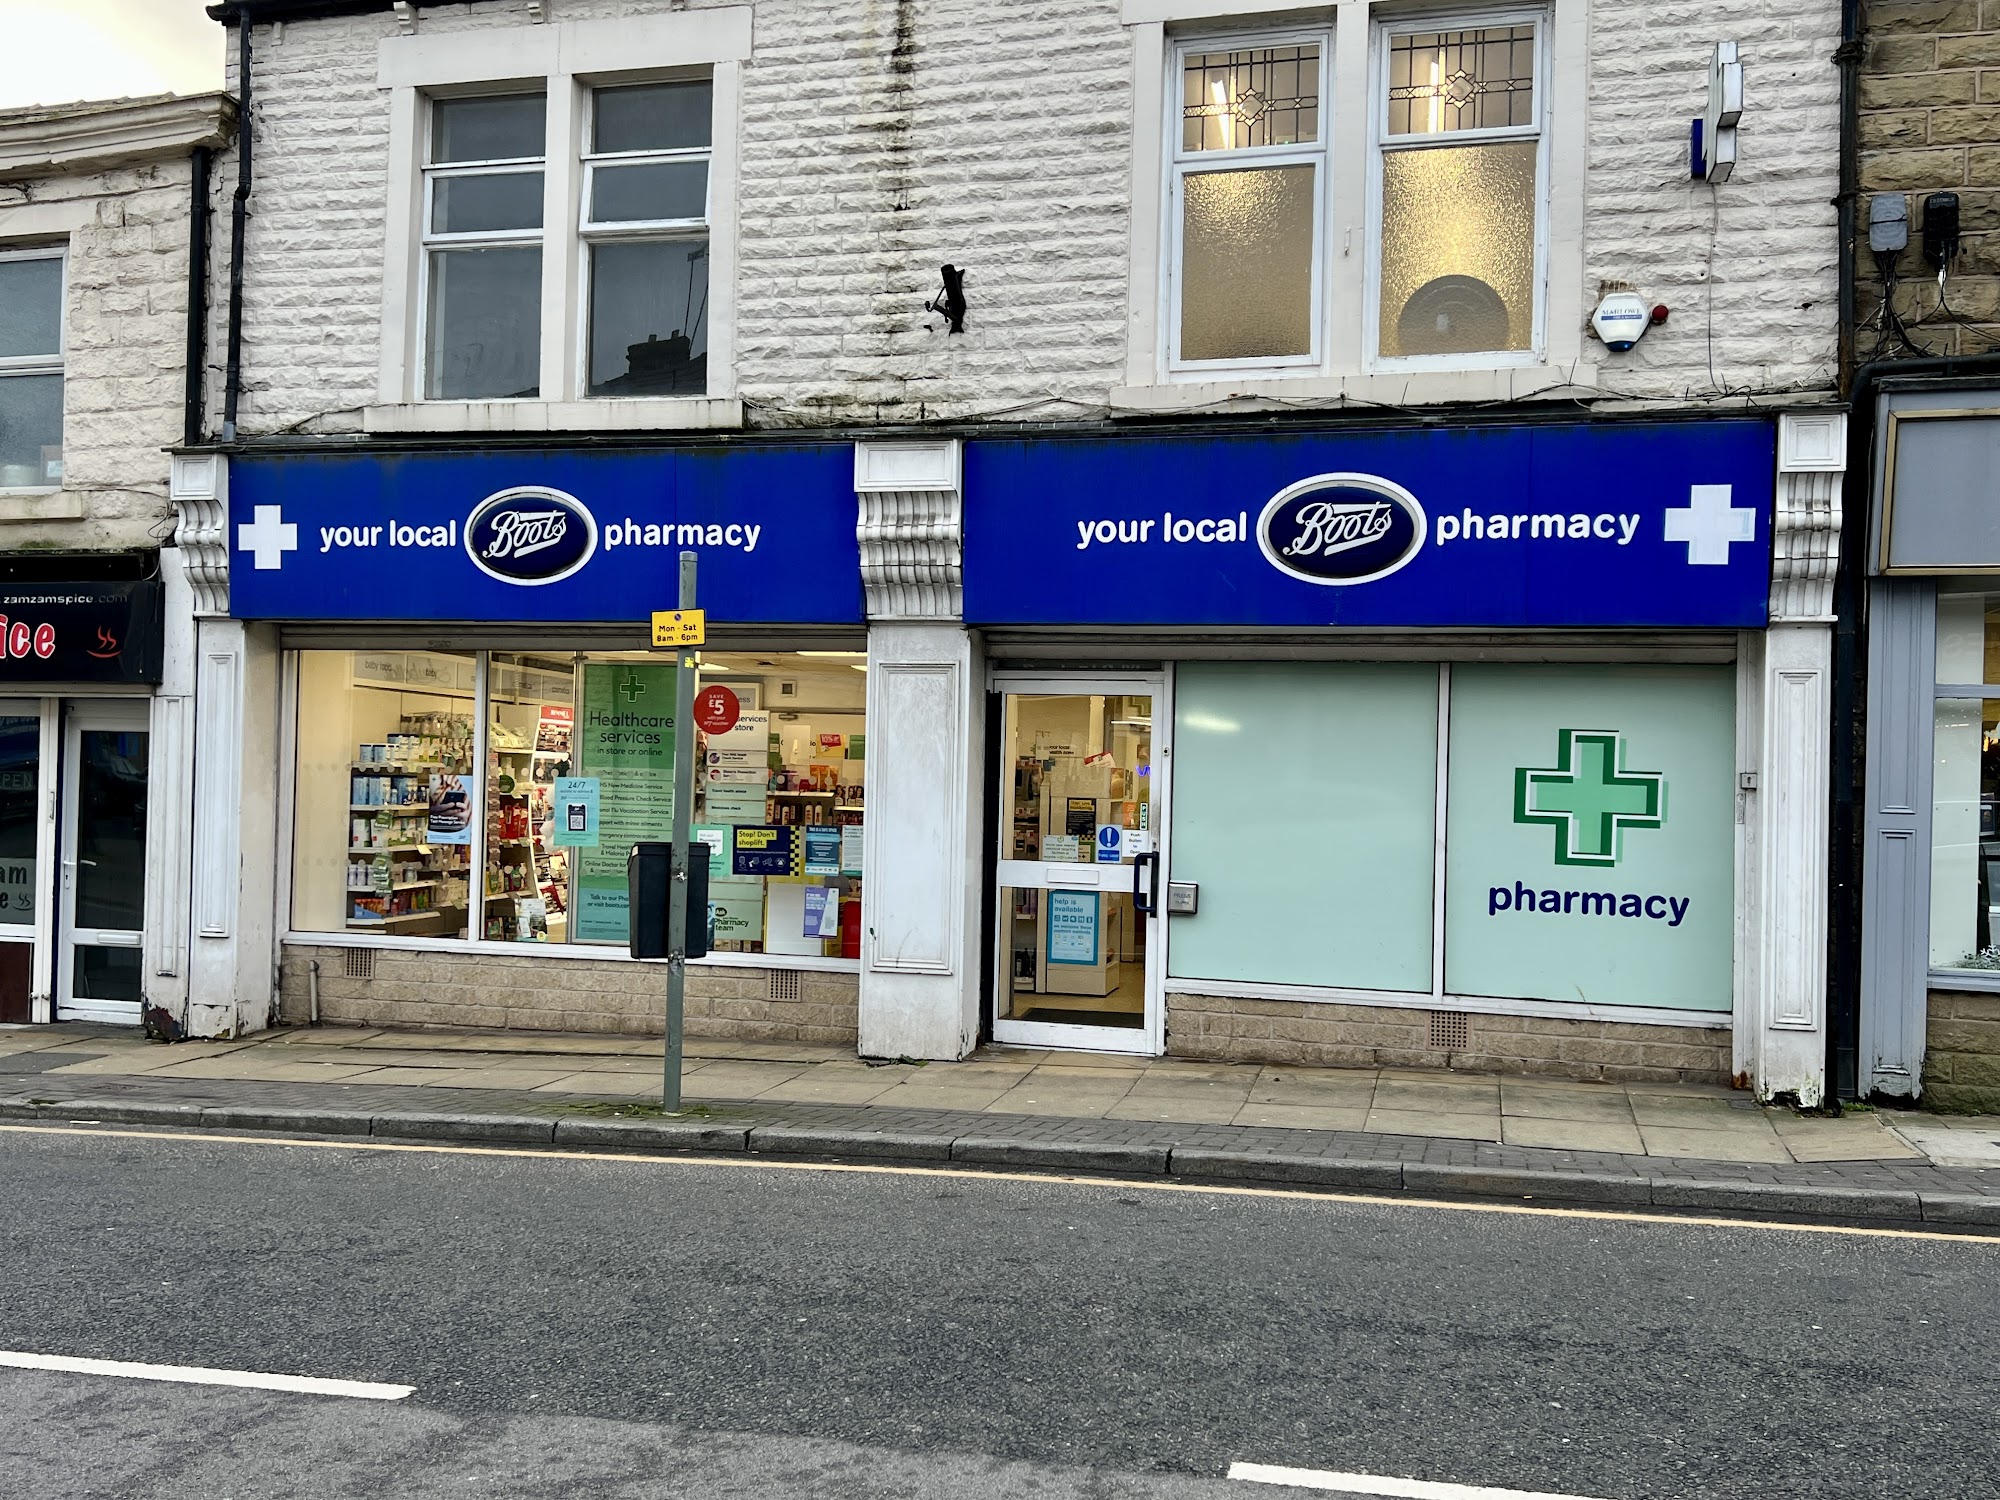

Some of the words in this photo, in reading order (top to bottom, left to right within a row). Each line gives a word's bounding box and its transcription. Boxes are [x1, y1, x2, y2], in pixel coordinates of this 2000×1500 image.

[320, 524, 383, 553] your
[389, 520, 456, 548] local
[482, 510, 568, 558] Boots
[604, 518, 761, 552] pharmacy
[1076, 515, 1156, 550] your
[1163, 510, 1247, 543] local
[1282, 502, 1393, 557] Boots
[1436, 507, 1641, 545] pharmacy
[708, 699, 725, 715] £5
[590, 710, 674, 728] Healthcare
[600, 730, 661, 744] services
[597, 746, 604, 754] in
[638, 748, 663, 756] online
[739, 839, 765, 847] shoplift.
[1488, 880, 1690, 926] pharmacy
[714, 918, 749, 927] Pharmacy
